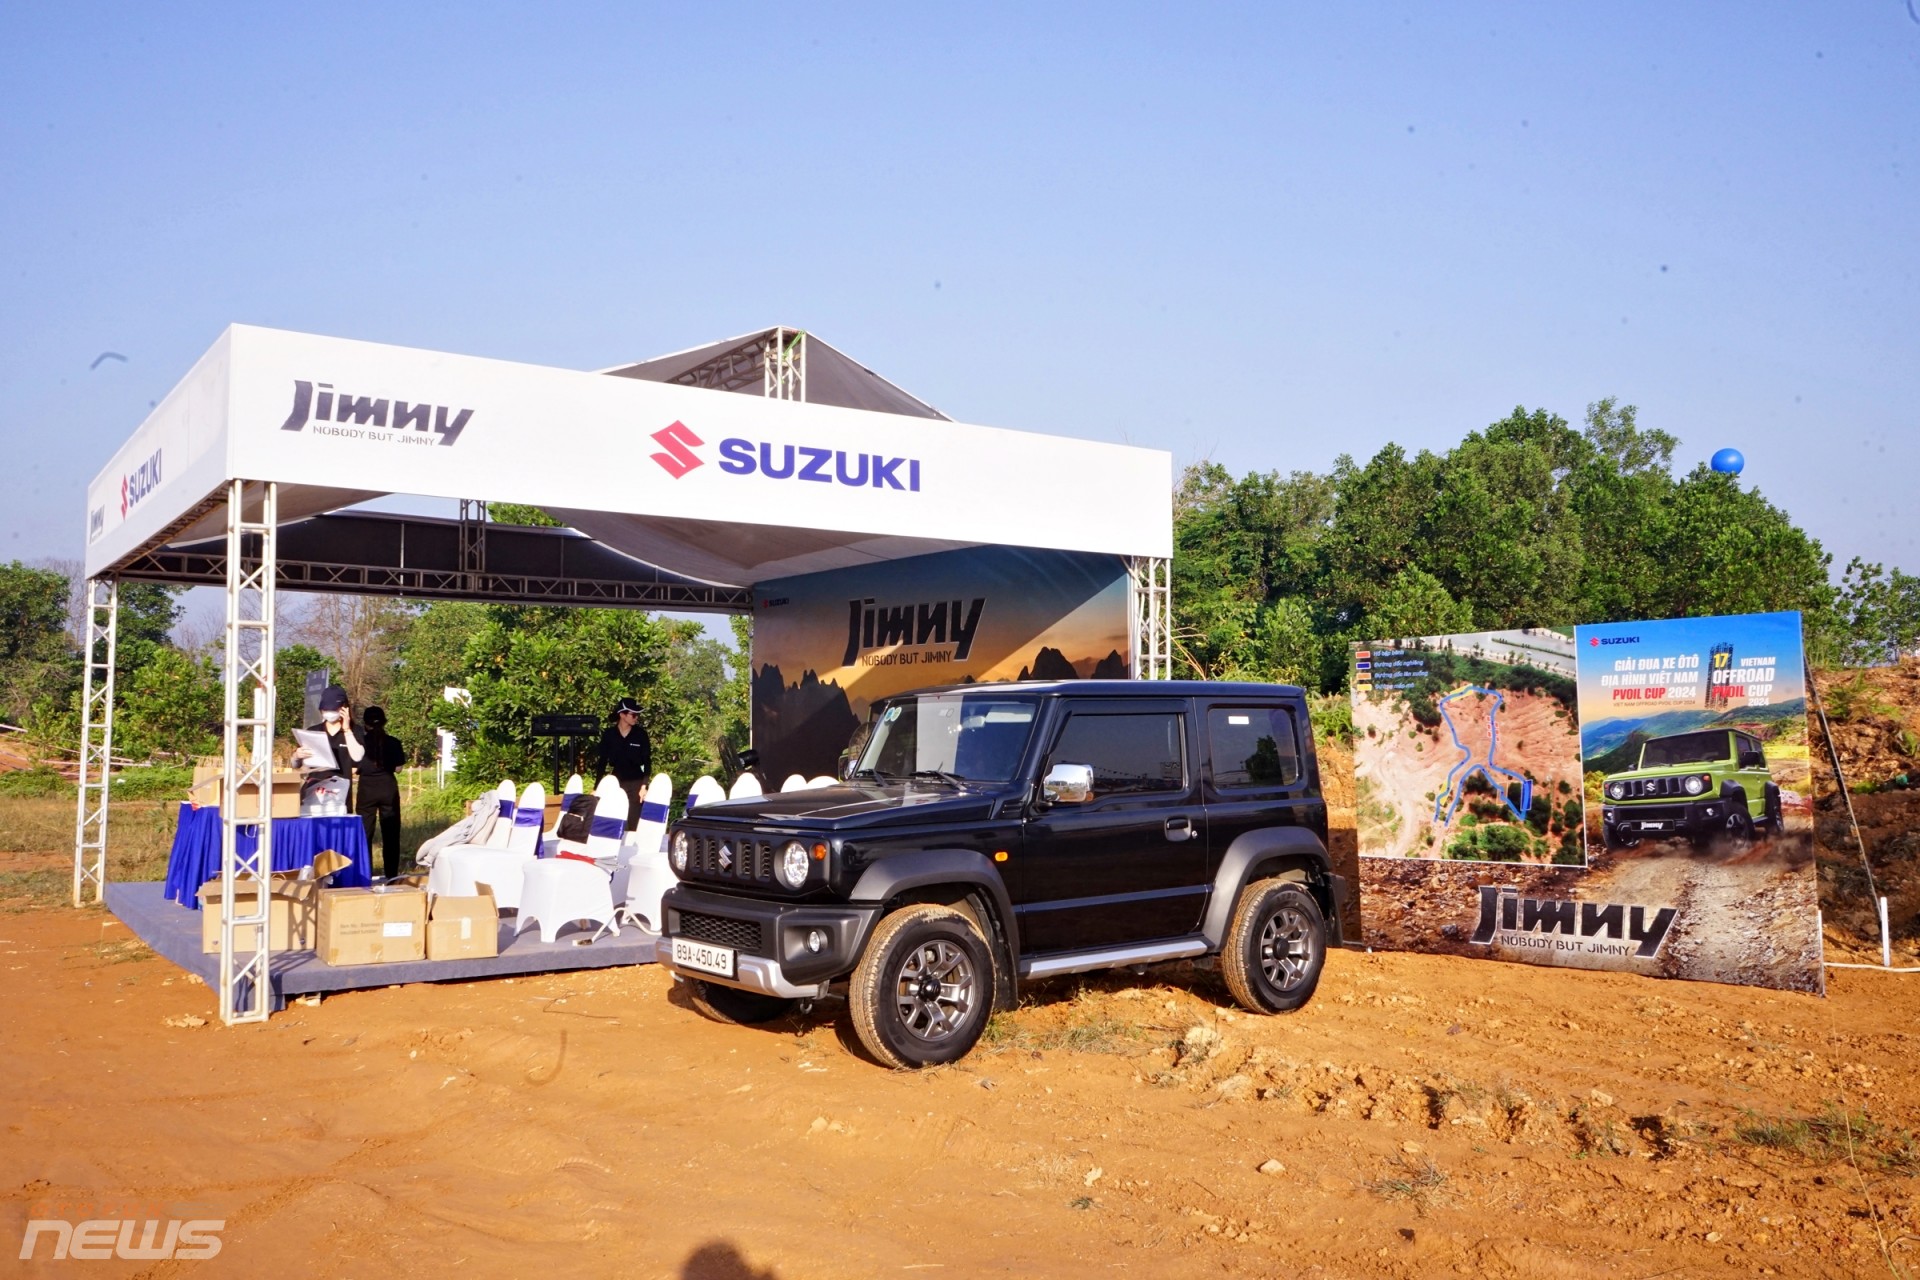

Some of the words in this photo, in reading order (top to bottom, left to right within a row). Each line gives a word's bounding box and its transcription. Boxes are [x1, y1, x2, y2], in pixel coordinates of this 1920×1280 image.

[280, 380, 475, 446] Jimny
[313, 426, 365, 439] NOBODY
[368, 431, 394, 442] BUT
[718, 438, 920, 492] SUZUKI
[129, 448, 161, 508] SUZUKI
[841, 597, 986, 668] Jimny
[1601, 637, 1640, 645] SUZUKI
[862, 653, 898, 667] NOBODY
[900, 652, 919, 665] BUT
[1614, 657, 1636, 672] GIẢI
[1638, 658, 1660, 671] ĐUA
[1662, 657, 1676, 669] XE
[1678, 653, 1699, 669] ÔTÔ
[1714, 653, 1729, 668] 17
[1740, 656, 1776, 667] VIETNAM
[1601, 675, 1619, 688] ĐỊA
[1621, 672, 1647, 686] HÌNH
[1649, 670, 1672, 686] VIỆT
[1673, 671, 1699, 684] NAM
[1712, 667, 1775, 684] OFFROAD
[1613, 688, 1642, 700] PVOIL
[1644, 687, 1667, 700] CUP
[1667, 686, 1696, 699] 2024
[1711, 685, 1745, 699] PVOIL
[1748, 684, 1773, 697] CUP
[1747, 697, 1770, 707] 2024
[1469, 885, 1679, 959] Jimny
[1501, 935, 1552, 949] NOBODY
[1556, 939, 1583, 952] BUT
[676, 944, 727, 970] 89A-450.49
